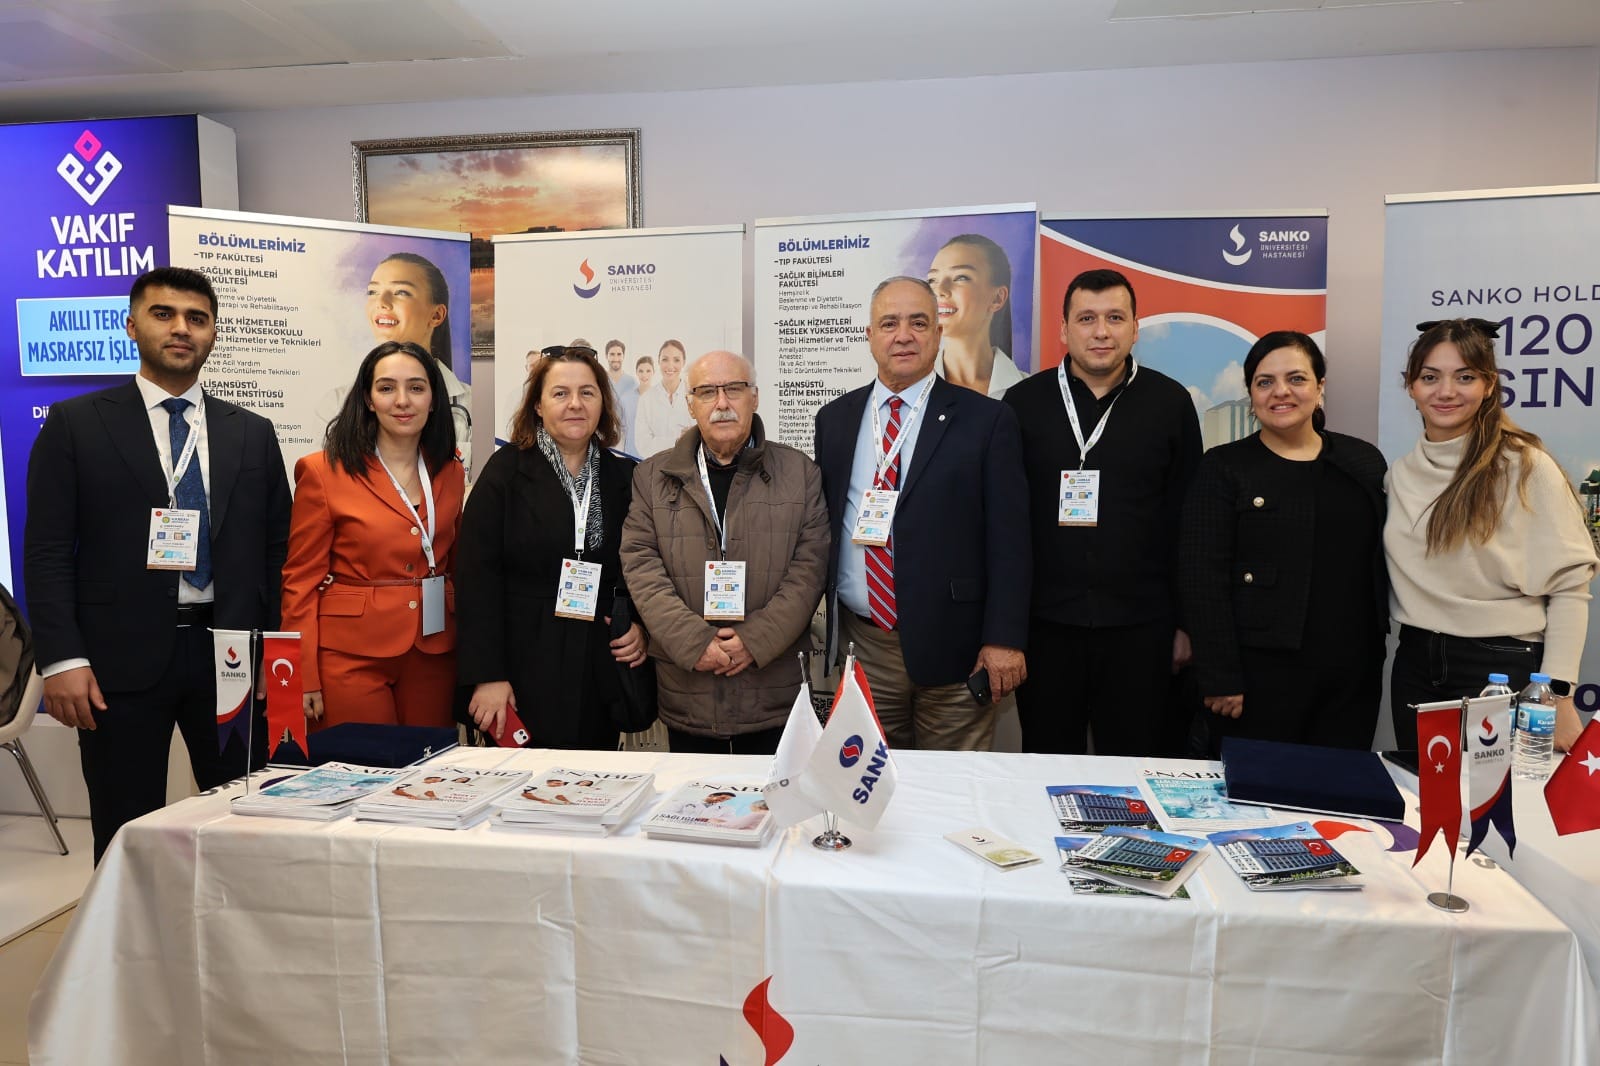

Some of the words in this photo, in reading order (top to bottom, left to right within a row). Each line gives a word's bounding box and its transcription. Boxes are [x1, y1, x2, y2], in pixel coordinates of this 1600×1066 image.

[51, 213, 135, 244] VAKIF
[1259, 231, 1310, 242] SANKO
[199, 232, 305, 252] BÖLÜMLERİMİZ
[778, 234, 870, 252] BÖLÜMLERİMİZ
[37, 246, 155, 279] KATILIM
[216, 252, 264, 263] FAKÜLTESİ
[792, 254, 832, 265] FAKÜLTESİ
[235, 268, 278, 278] BİLİMLERİ
[608, 264, 656, 276] SANKO
[807, 268, 844, 278] BİLİMLERİ
[779, 279, 818, 288] FAKÜLTESİ
[1431, 287, 1522, 307] SANKO
[218, 302, 238, 310] terapi
[50, 310, 90, 331] AKILLI
[236, 316, 288, 327] HİZMETLERİ
[807, 316, 852, 326] HİZMETLERİ
[215, 326, 238, 334] SLEK
[239, 326, 303, 336] YÜKSEKOKULU
[779, 327, 808, 335] MESLEK
[810, 325, 865, 334] YÜKSEKOKULU
[1499, 313, 1593, 356] 120
[226, 336, 267, 344] Hizmetler
[281, 338, 321, 346] Teknikleri
[779, 336, 797, 344] Tıbbi
[798, 336, 834, 344] Hizmetler
[846, 335, 869, 343] Teknik
[28, 341, 105, 362] MASRAFSIZ
[109, 336, 141, 364] İŞLE
[214, 345, 250, 354] eliyathane
[237, 389, 284, 398] ENSTİTÜSÜ
[779, 387, 804, 396] EĞİTİM
[258, 400, 284, 408] Lisans
[274, 423, 301, 431] ilitasyon
[1474, 748, 1505, 760] SANKO
[852, 739, 888, 804] SANK
[1156, 771, 1221, 779] NABI
